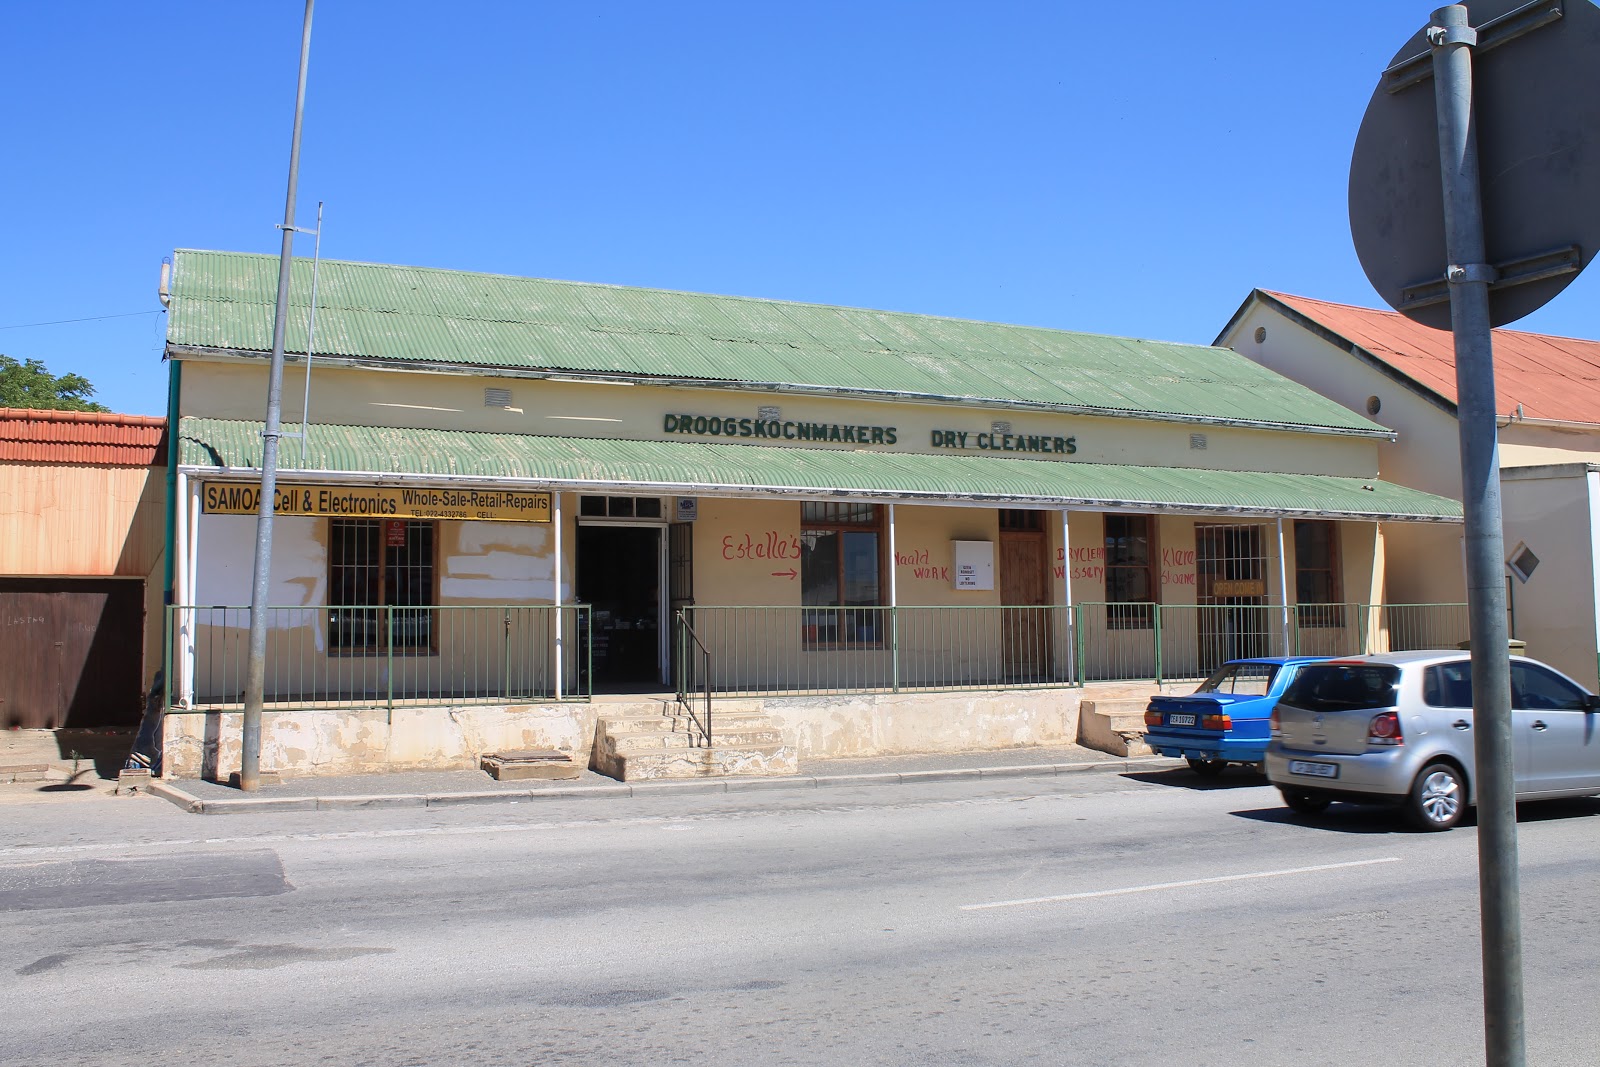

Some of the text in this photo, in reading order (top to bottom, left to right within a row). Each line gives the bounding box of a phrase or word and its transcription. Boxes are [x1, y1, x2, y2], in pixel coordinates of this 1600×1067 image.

[931, 430, 1077, 454] DRY CLEANERS
[207, 486, 397, 515] SAMOA Cell & Electronics
[402, 489, 548, 512] Whole-Sale-Retail-Repairs
[722, 530, 802, 561] Estelle's
[1213, 581, 1264, 596] OPEN COME IN
